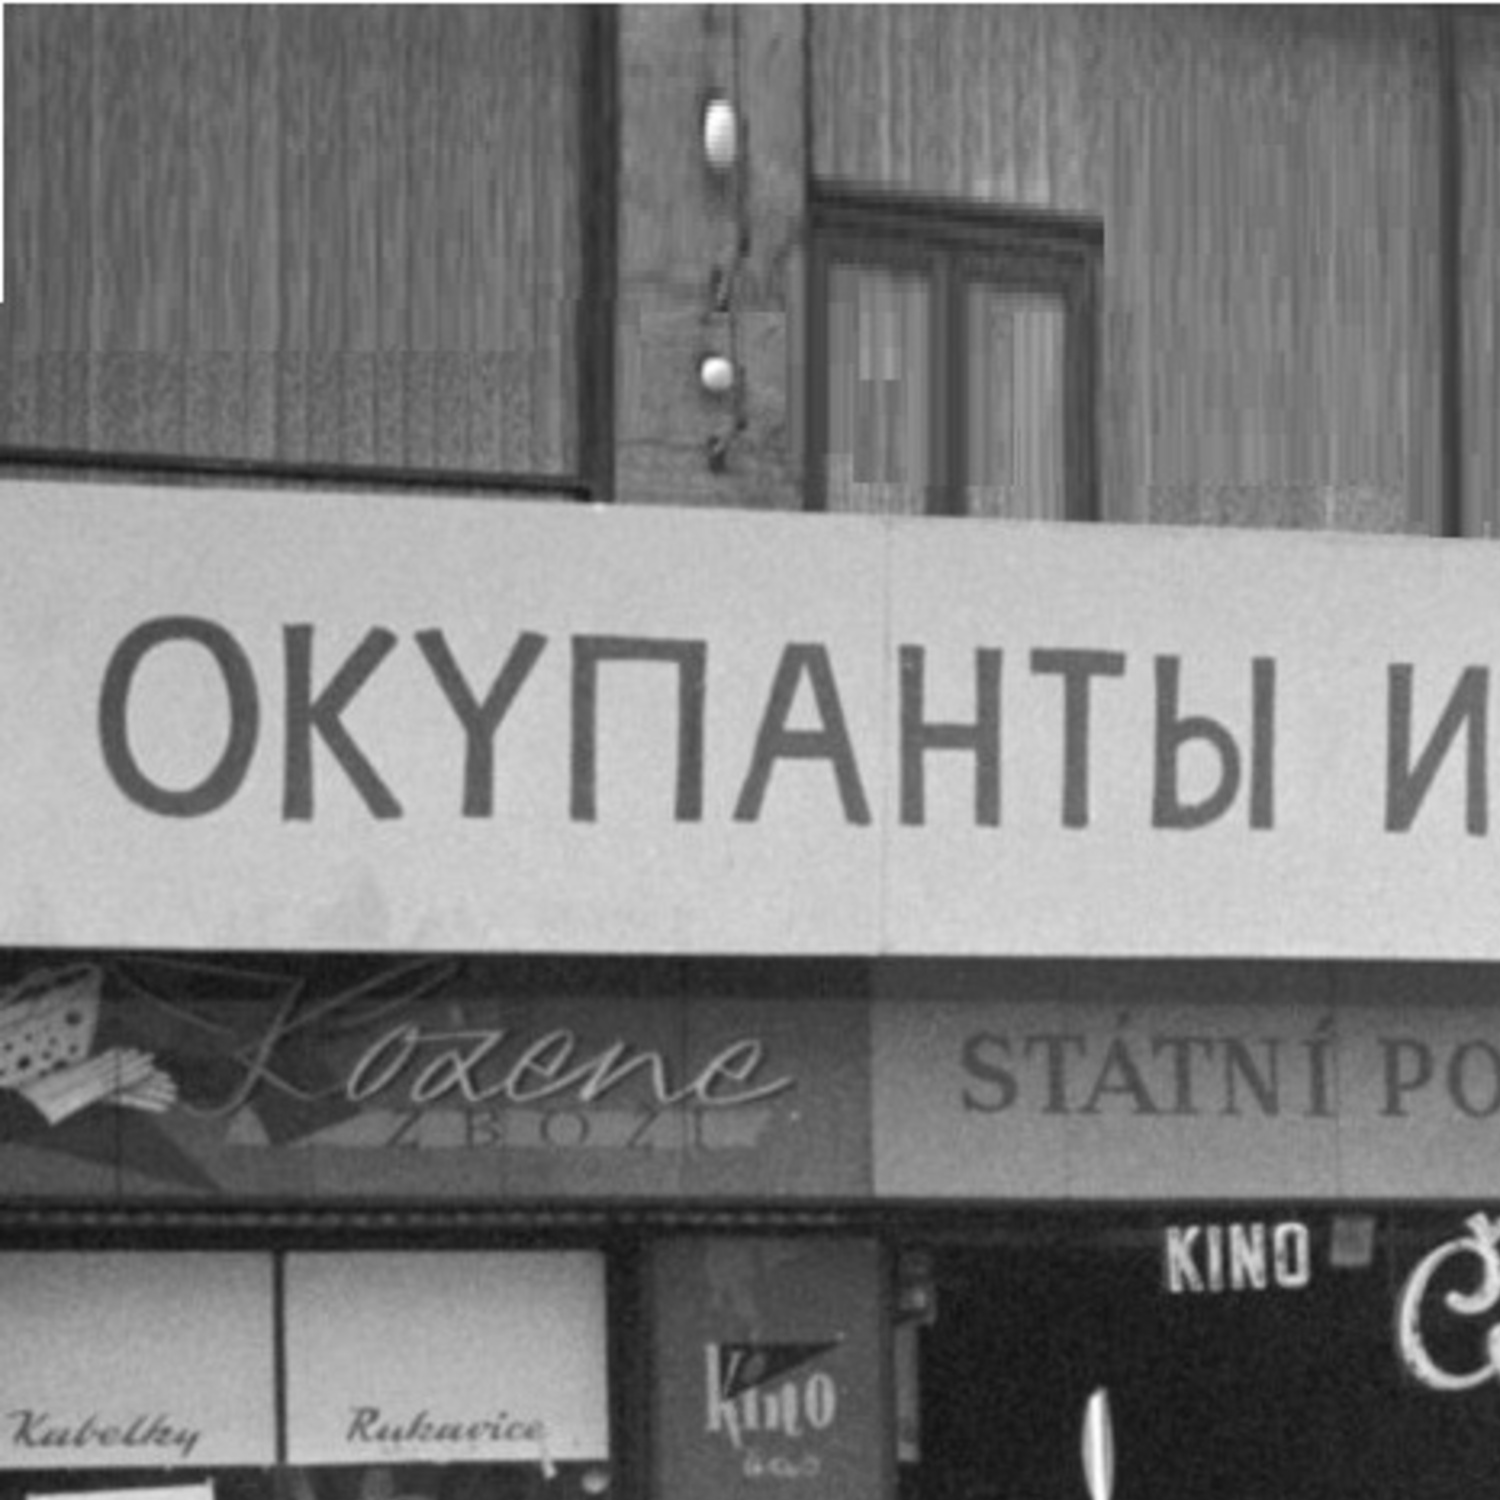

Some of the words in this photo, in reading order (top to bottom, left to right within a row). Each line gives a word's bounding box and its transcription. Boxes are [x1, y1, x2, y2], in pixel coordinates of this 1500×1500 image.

[97, 613, 1277, 832] ОКУПАНТЫ
[960, 1014, 1339, 1117] STÁTNÍ
[1165, 1221, 1311, 1294] KINO
[6, 1408, 202, 1457] Kabelky
[346, 1406, 546, 1443] Rukavice
